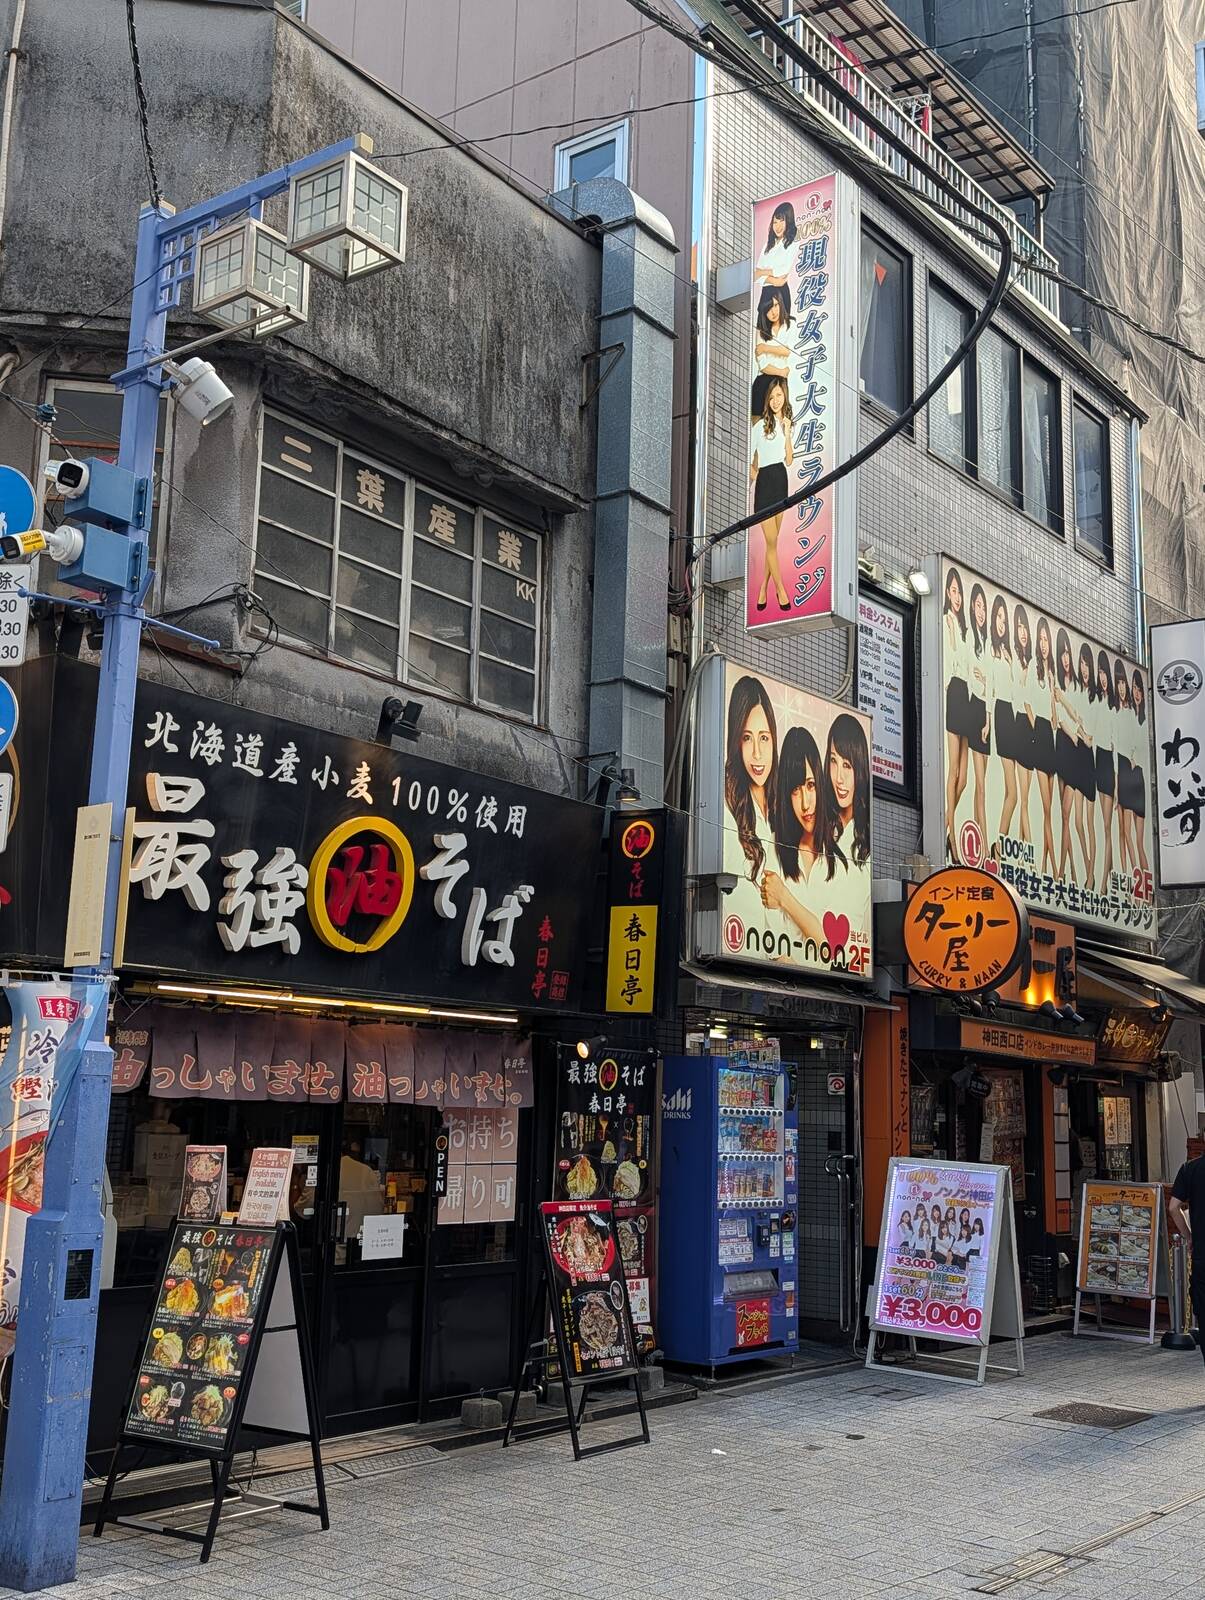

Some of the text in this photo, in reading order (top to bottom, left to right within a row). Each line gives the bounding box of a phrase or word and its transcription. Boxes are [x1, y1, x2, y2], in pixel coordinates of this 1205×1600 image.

[792, 236, 829, 607] 現役女子大生ラウンジ
[281, 435, 523, 571] 二葉産業
[516, 579, 535, 604] KK
[859, 603, 900, 633] 料金システム
[144, 711, 528, 840] 北海道産小麦100%使用
[129, 772, 536, 968] 最強油そば
[1132, 867, 1153, 900] 2F
[928, 886, 995, 901] インド定食
[1000, 864, 1154, 930] 現役女子大生だけのラウンジ
[914, 901, 1010, 942] ターリー
[530, 915, 555, 1000] 春日亭
[620, 913, 648, 1006] 春日亭
[746, 926, 847, 969] non-non
[848, 945, 871, 973] 2F
[942, 935, 970, 972] 屋
[919, 959, 1003, 990] CURRY & NAAN
[982, 1028, 1025, 1052] 神田西口店
[589, 1092, 627, 1114] 春日亭
[663, 1111, 692, 1119] DRINKS
[897, 1169, 939, 1185] 100%
[896, 1255, 936, 1270] ¥3,000
[882, 1294, 983, 1332] ¥3,000
